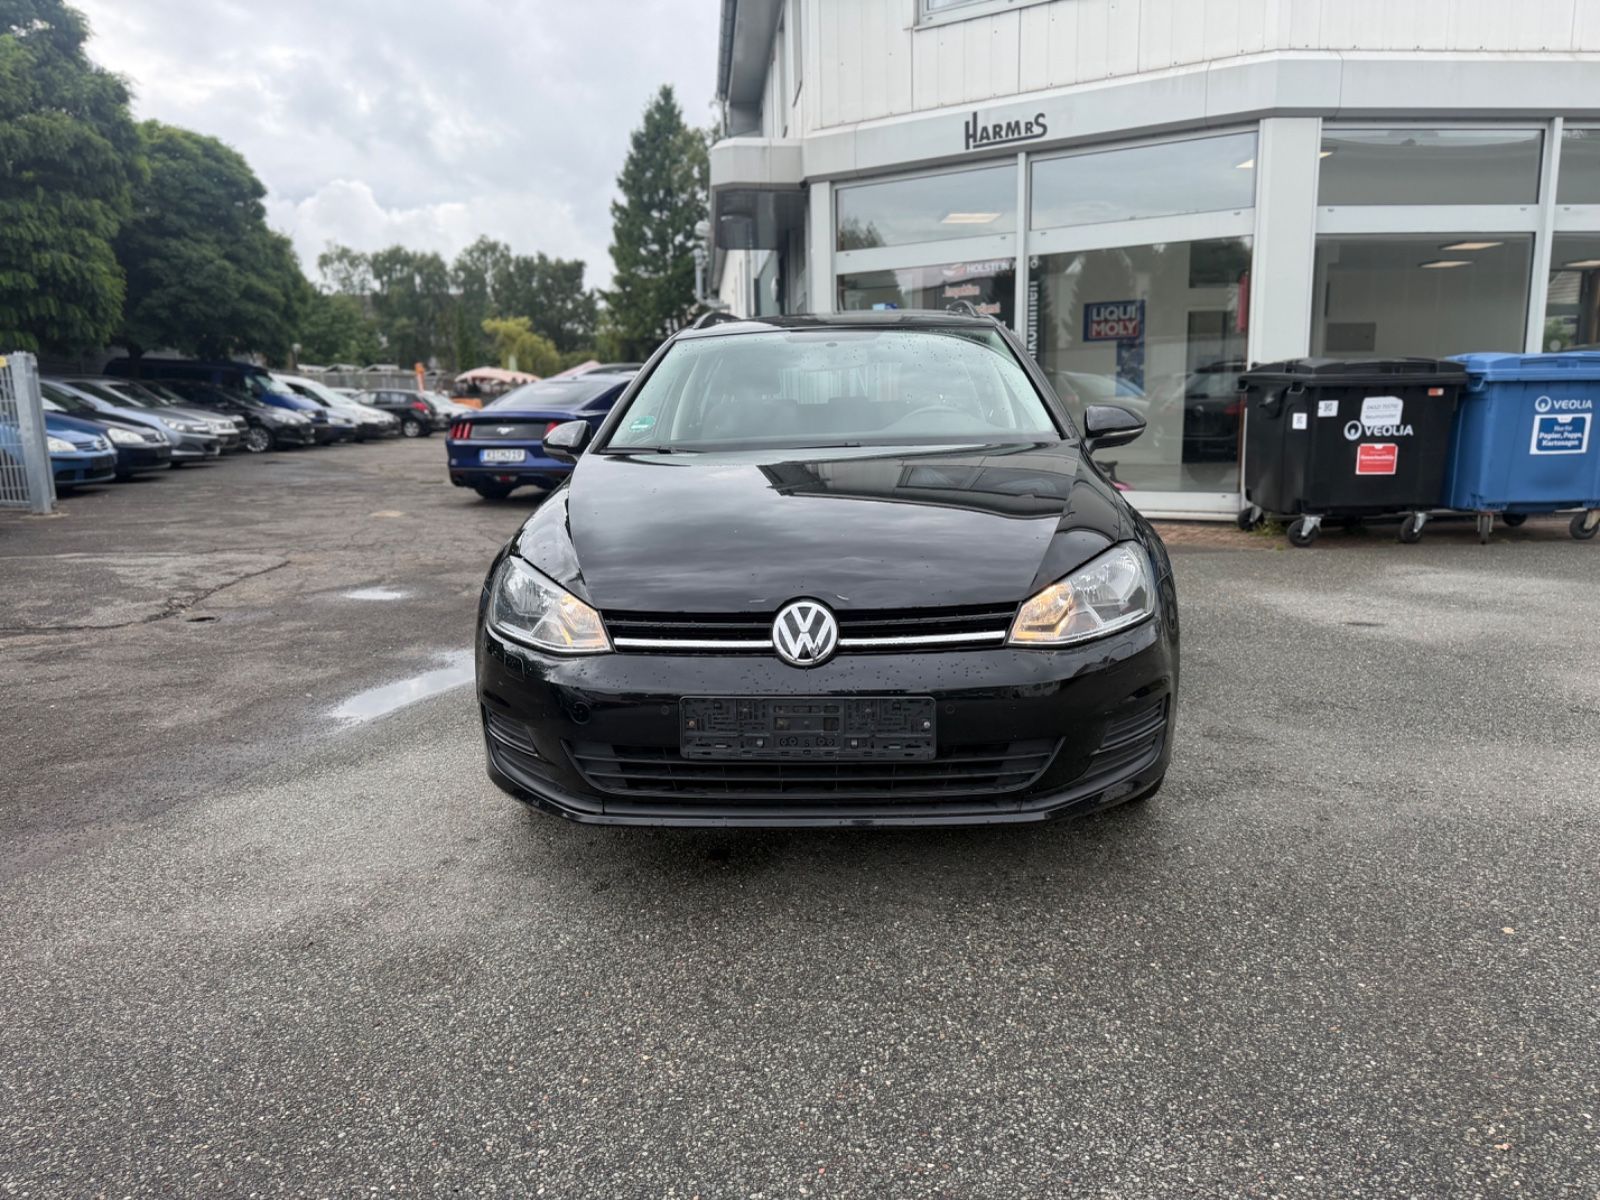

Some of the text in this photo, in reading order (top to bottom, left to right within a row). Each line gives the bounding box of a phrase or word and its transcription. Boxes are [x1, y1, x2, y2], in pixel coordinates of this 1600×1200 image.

[1092, 305, 1136, 320] LIQUI
[1092, 320, 1138, 336] MOLY
[1553, 399, 1592, 409] VEOLIA
[1364, 424, 1414, 436] VEOLIA
